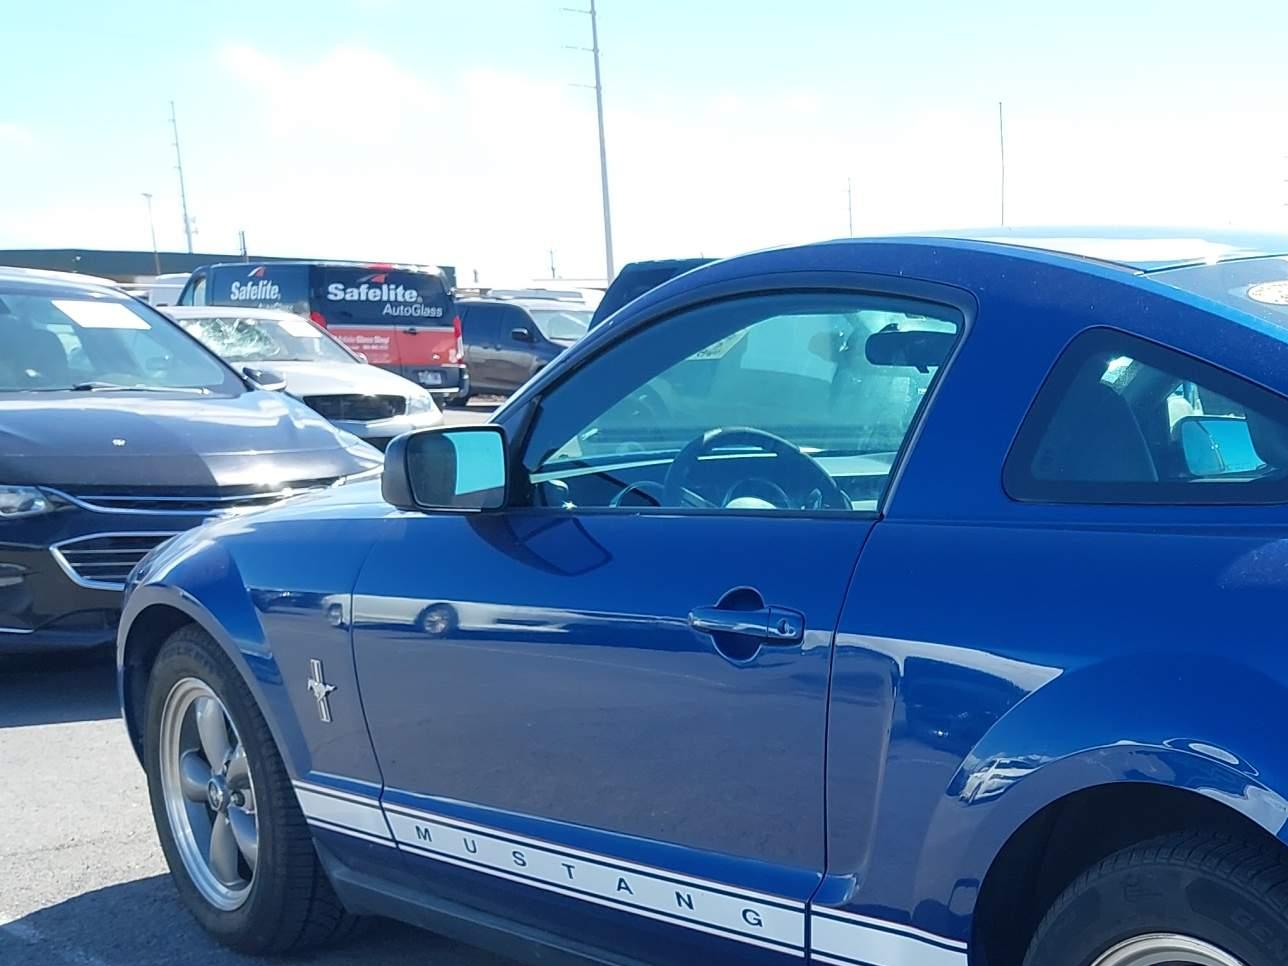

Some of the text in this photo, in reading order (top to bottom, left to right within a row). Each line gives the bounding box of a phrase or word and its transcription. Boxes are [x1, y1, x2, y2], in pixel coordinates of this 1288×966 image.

[230, 280, 280, 300] Safelite
[327, 283, 418, 302] Safelite
[382, 303, 443, 317] AutoGlass
[414, 824, 764, 928] MUSTANG
